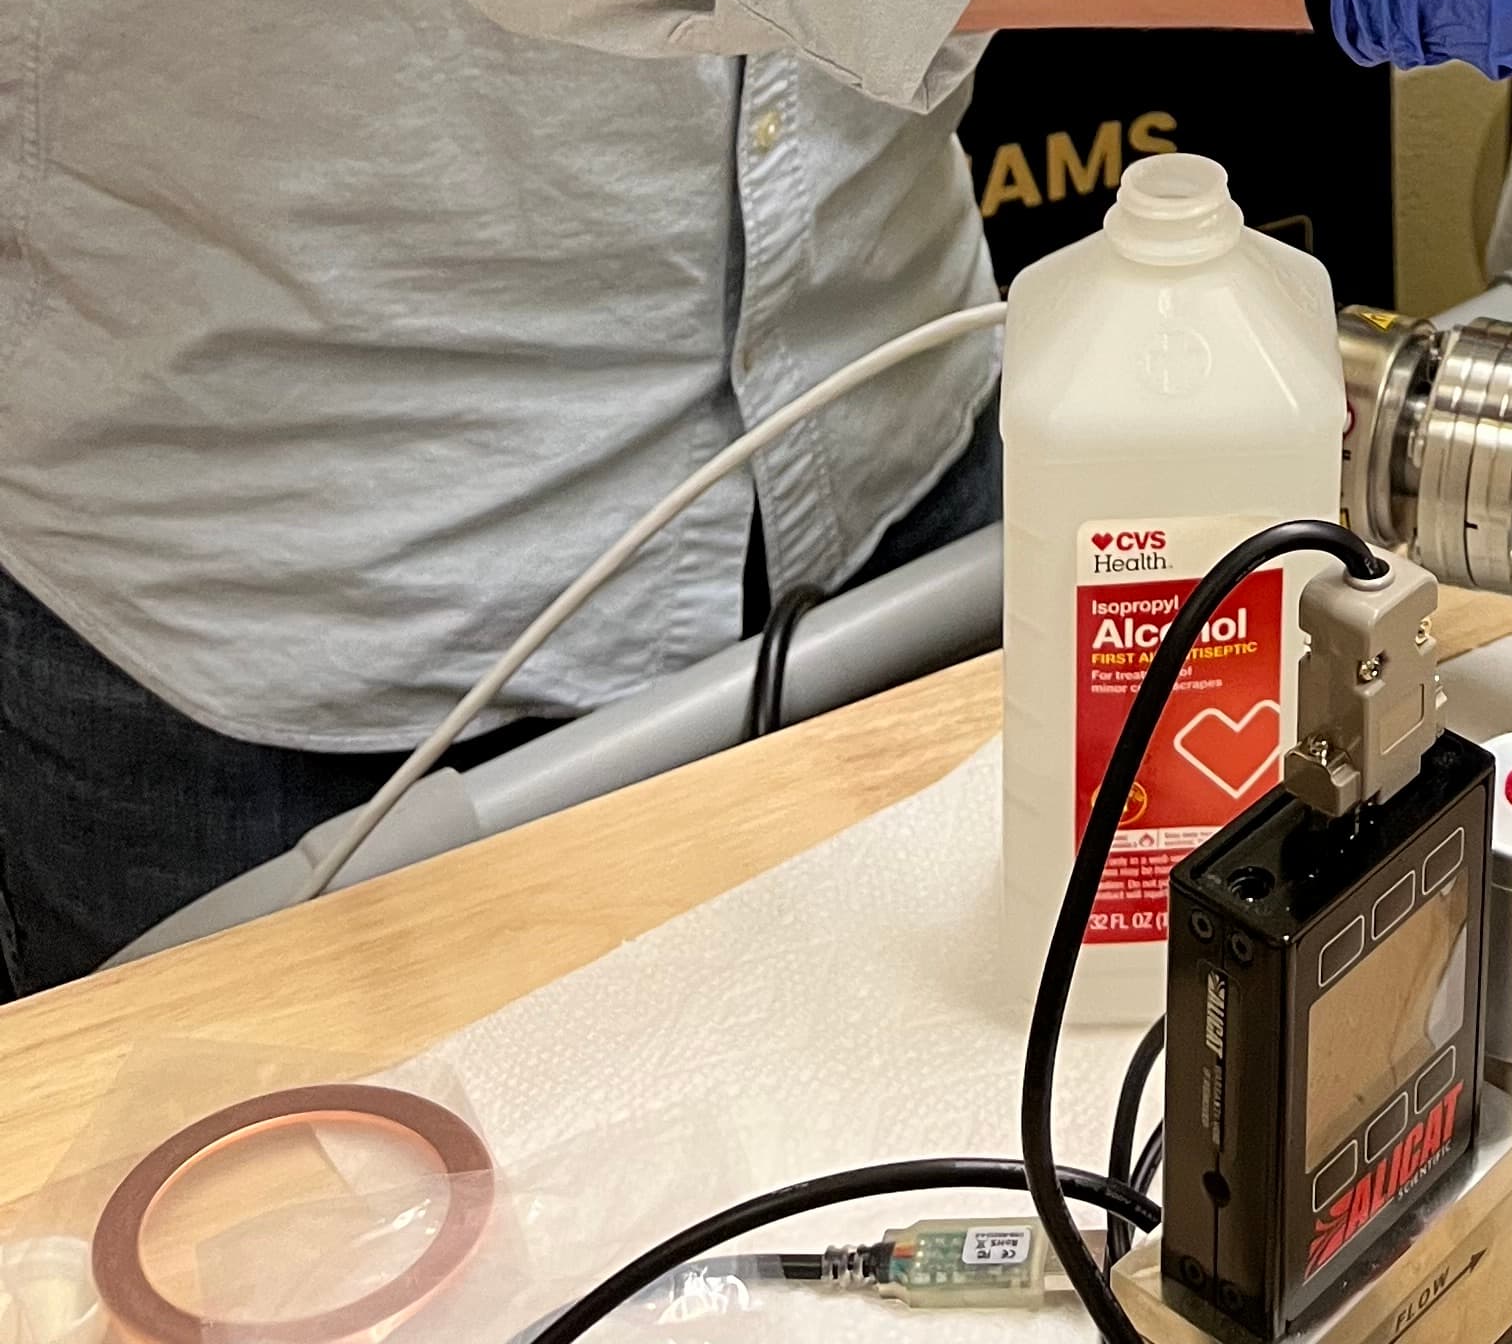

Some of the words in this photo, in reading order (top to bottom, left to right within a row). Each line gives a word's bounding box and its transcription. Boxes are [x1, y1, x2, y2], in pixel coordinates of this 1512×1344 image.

[970, 111, 1178, 219] AMS
[1116, 531, 1167, 552] CVS
[1094, 552, 1167, 573] Health
[1091, 595, 1179, 617] Isopropyl
[1091, 607, 1247, 649] Alcol
[1091, 653, 1135, 665] FIRST
[1138, 653, 1154, 663] AI
[1185, 642, 1258, 660] TISEPTIC
[1091, 683, 1127, 693] minor
[1110, 913, 1129, 929] FL
[1132, 911, 1153, 928] OZ
[1335, 1080, 1464, 1252] ALICAT
[1397, 1139, 1452, 1199] SCIENTIFIC
[1394, 1265, 1451, 1334] FLOW
